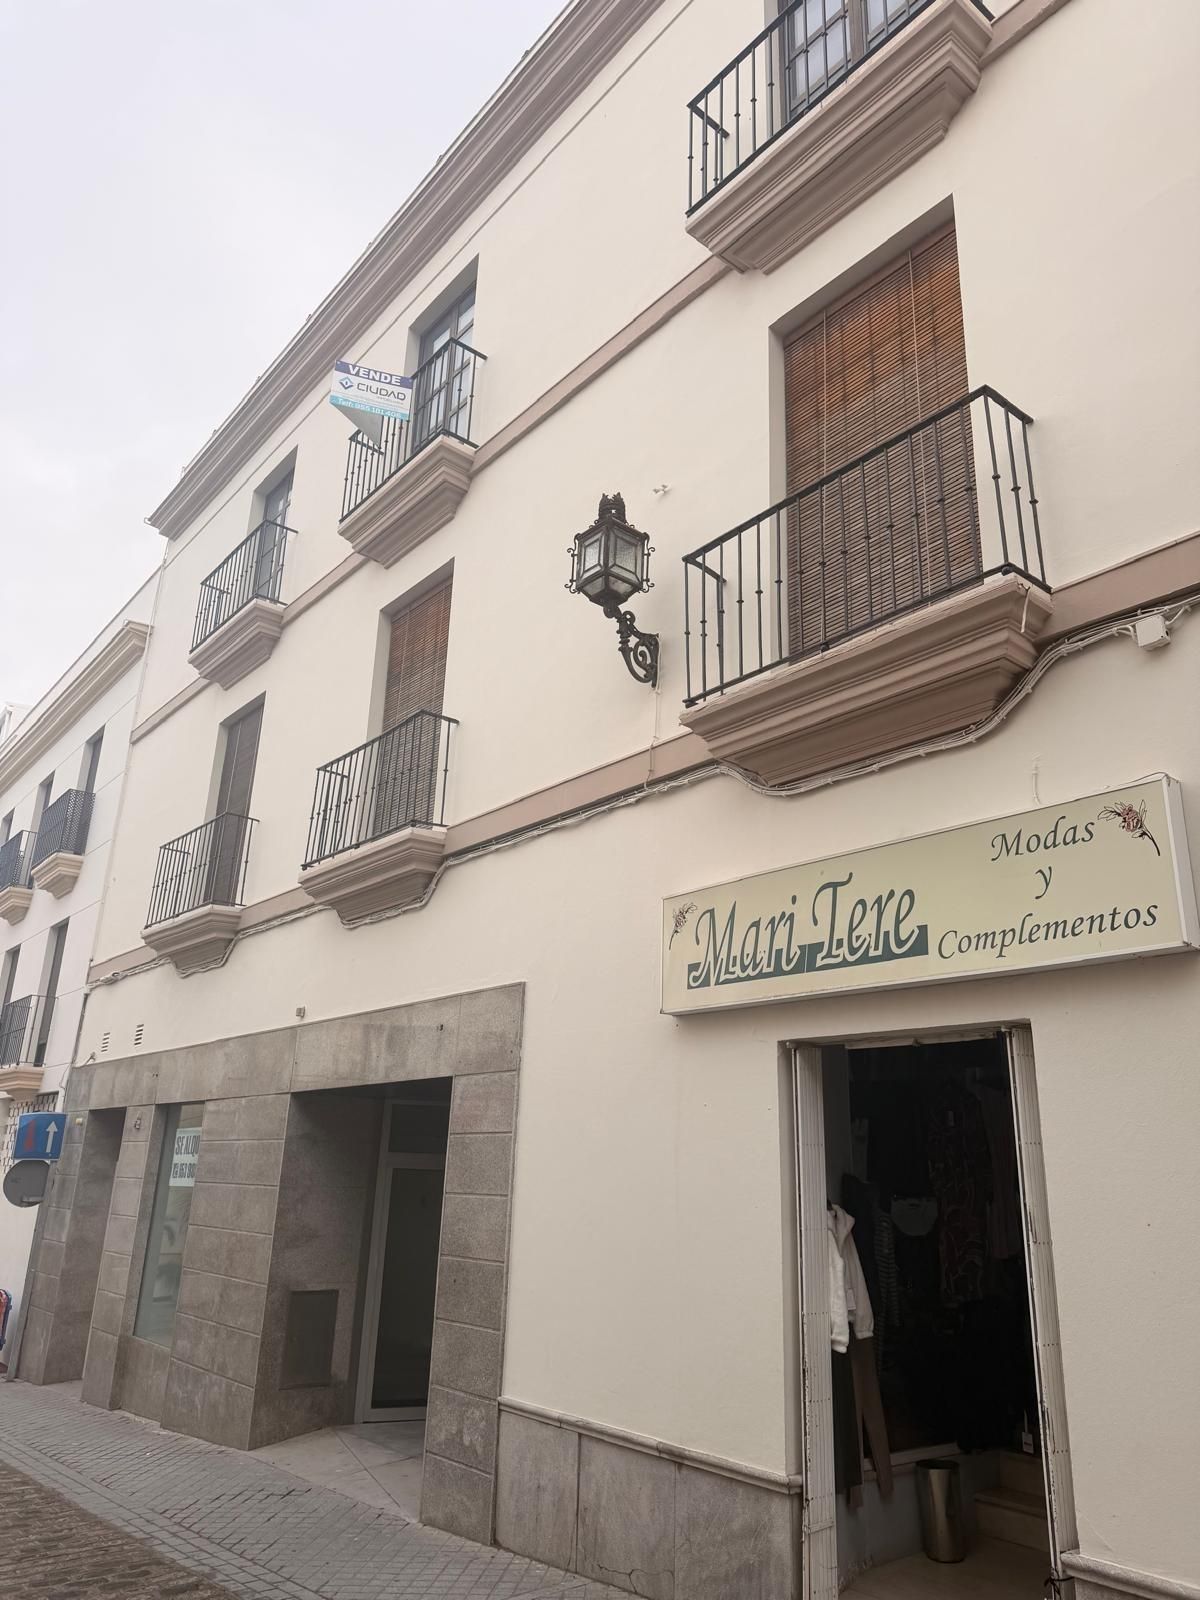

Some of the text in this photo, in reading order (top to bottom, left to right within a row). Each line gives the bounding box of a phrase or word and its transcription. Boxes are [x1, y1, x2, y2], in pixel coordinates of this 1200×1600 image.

[349, 365, 401, 385] VENDE
[356, 383, 406, 401] CIUDAD
[991, 815, 1096, 862] Modas
[1034, 864, 1053, 900] y
[689, 871, 922, 987] Mari Tere
[937, 903, 1159, 960] Complementos
[175, 1136, 185, 1155] SE
